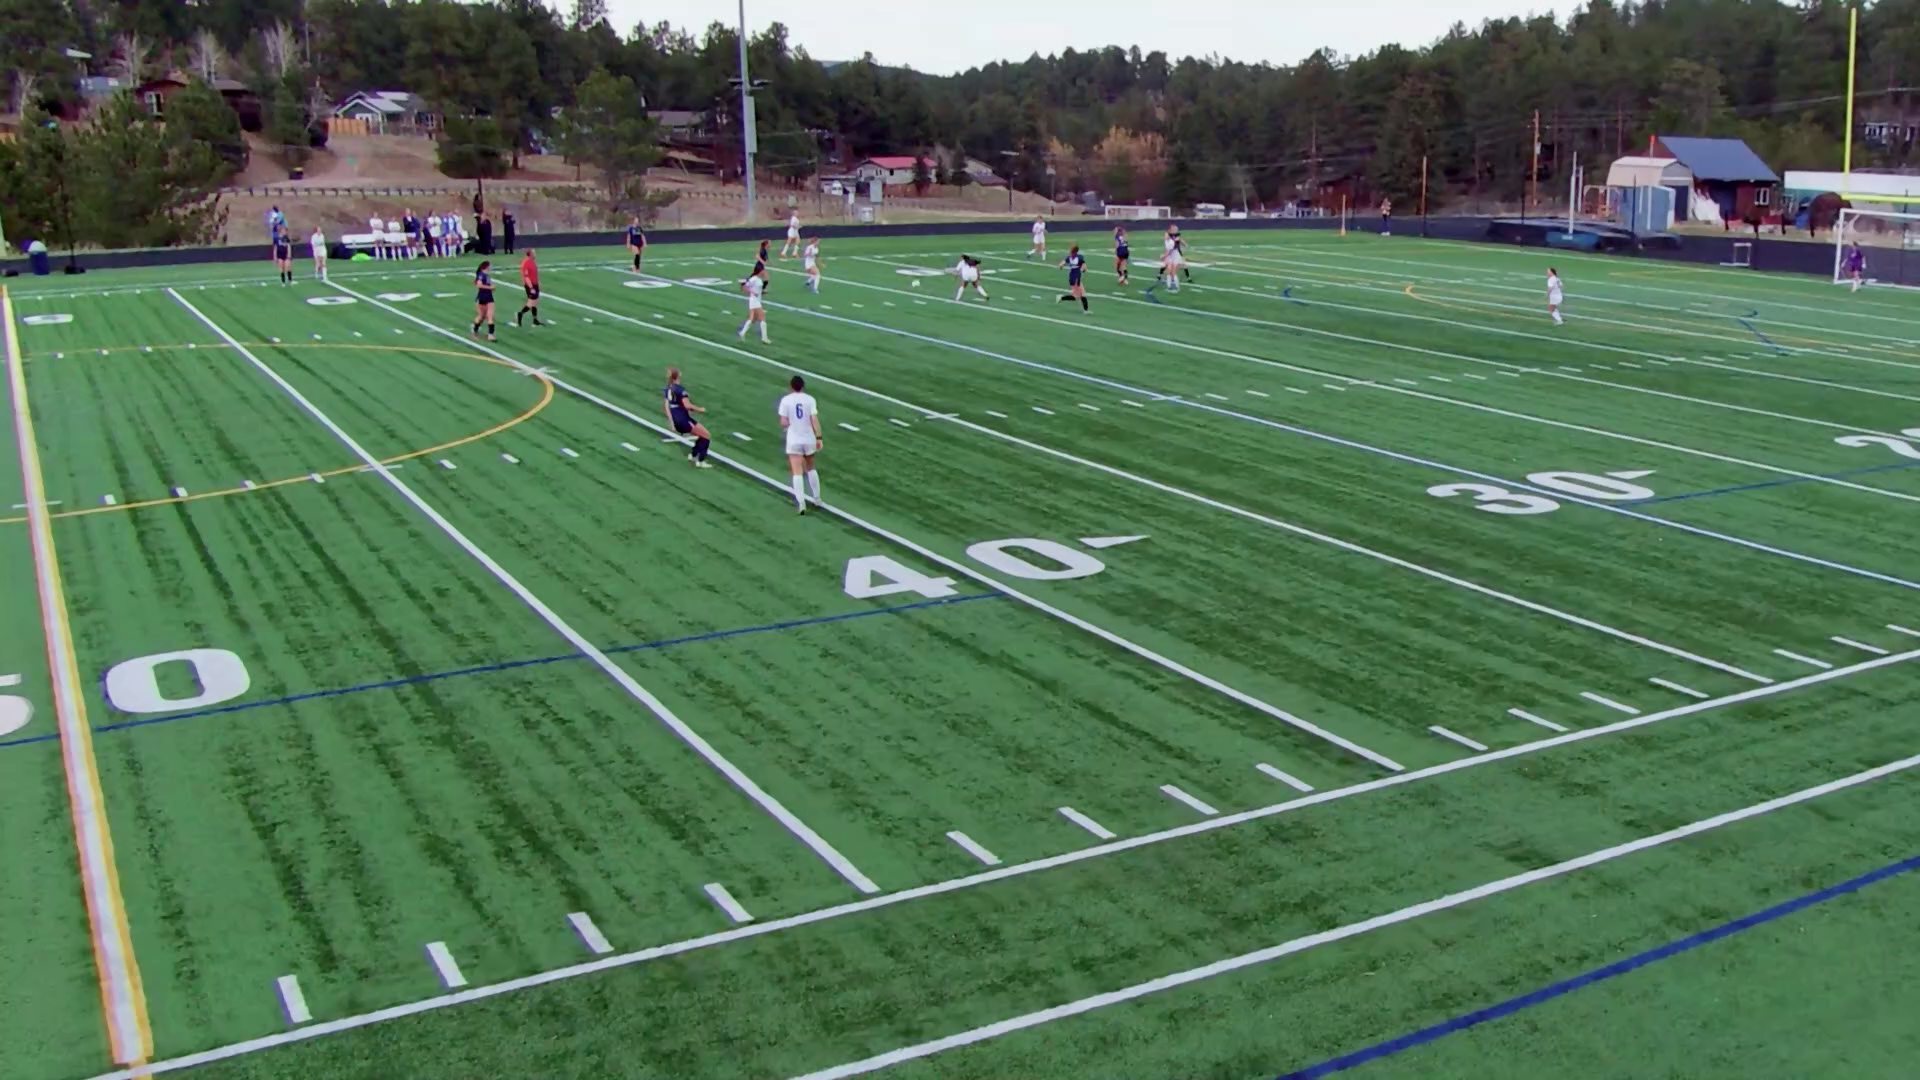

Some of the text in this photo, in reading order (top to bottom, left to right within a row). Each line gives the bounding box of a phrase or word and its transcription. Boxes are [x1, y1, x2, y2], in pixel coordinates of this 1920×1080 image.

[796, 403, 804, 419] 6
[1834, 428, 1920, 460] 2
[1426, 471, 1655, 515] 30
[844, 538, 1105, 599] 40
